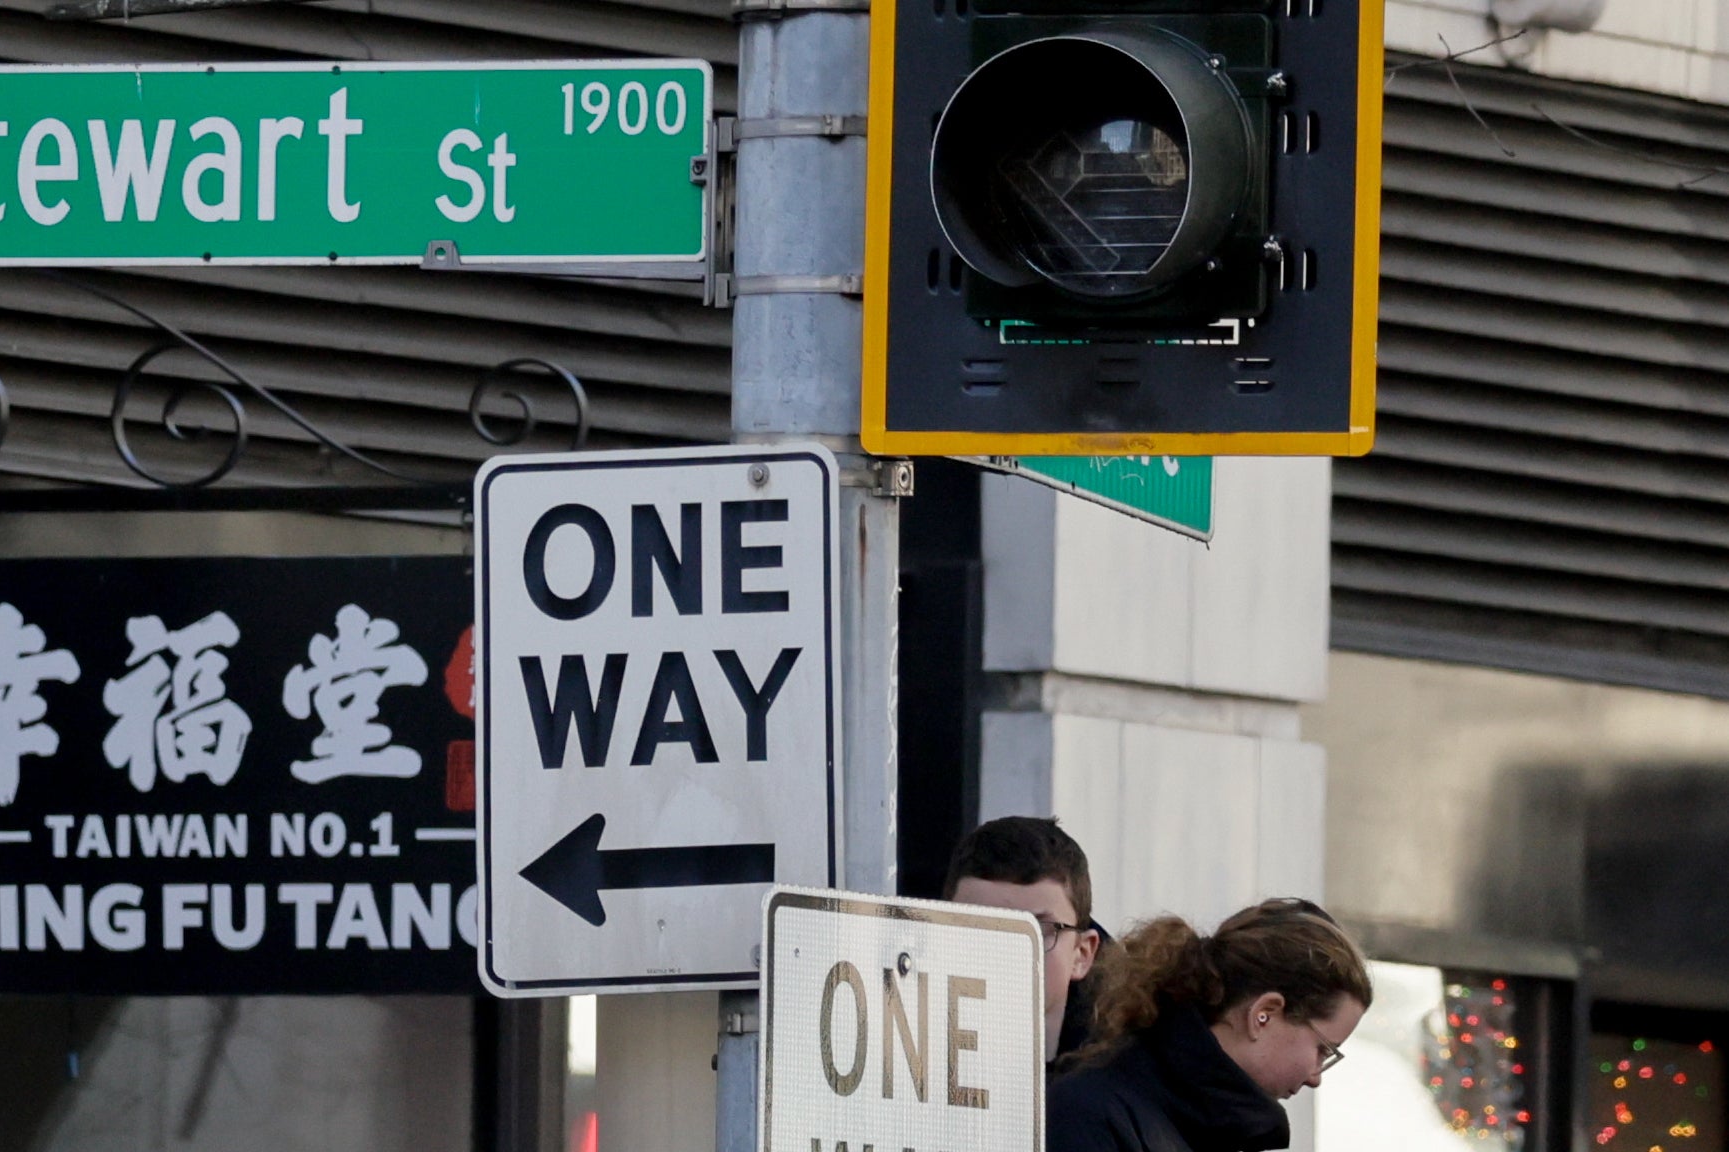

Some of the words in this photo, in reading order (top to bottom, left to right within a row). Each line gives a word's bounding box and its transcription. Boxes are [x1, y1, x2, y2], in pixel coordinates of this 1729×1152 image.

[435, 128, 517, 223] St
[561, 80, 687, 137] 1900
[522, 498, 790, 621] ONE
[518, 647, 803, 770] WAY
[44, 813, 249, 858] TAIWAN
[270, 811, 401, 858] NO.1
[162, 883, 267, 951] FU
[819, 959, 990, 1110] ONE
